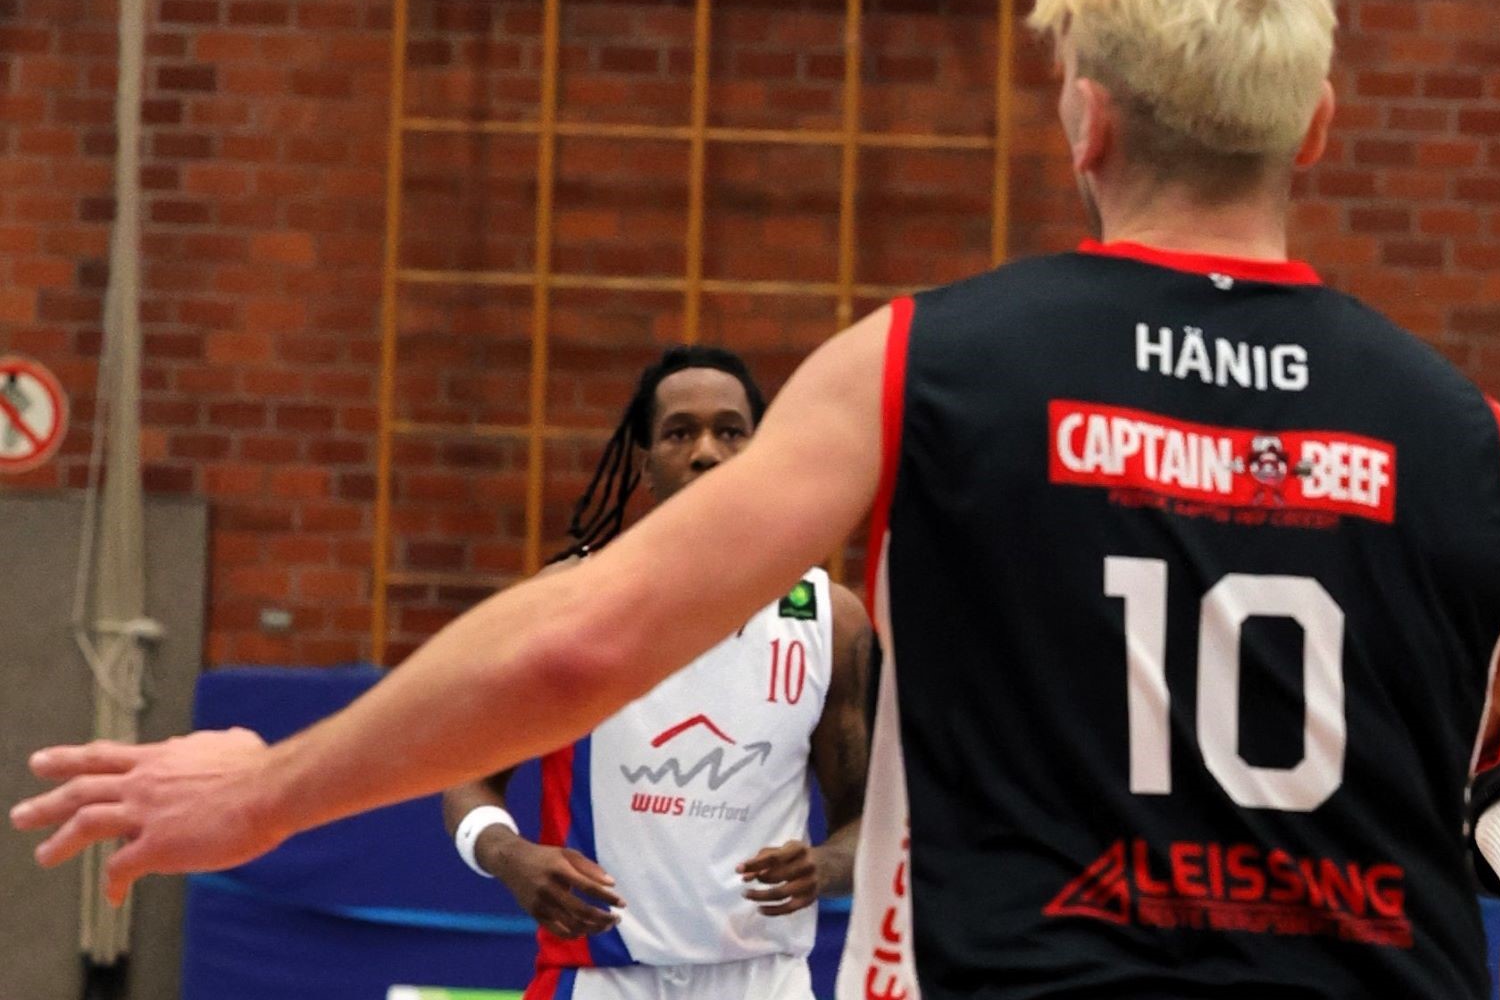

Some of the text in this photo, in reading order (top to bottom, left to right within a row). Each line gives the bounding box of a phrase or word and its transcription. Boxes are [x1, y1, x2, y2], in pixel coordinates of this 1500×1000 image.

[1135, 322, 1310, 391] HÄNIG
[1057, 412, 1390, 508] CAPTAIN BEEF
[767, 638, 806, 705] 10
[1104, 555, 1347, 812] 10
[631, 793, 750, 822] WWS Herford
[1133, 839, 1405, 918] LEISSING
